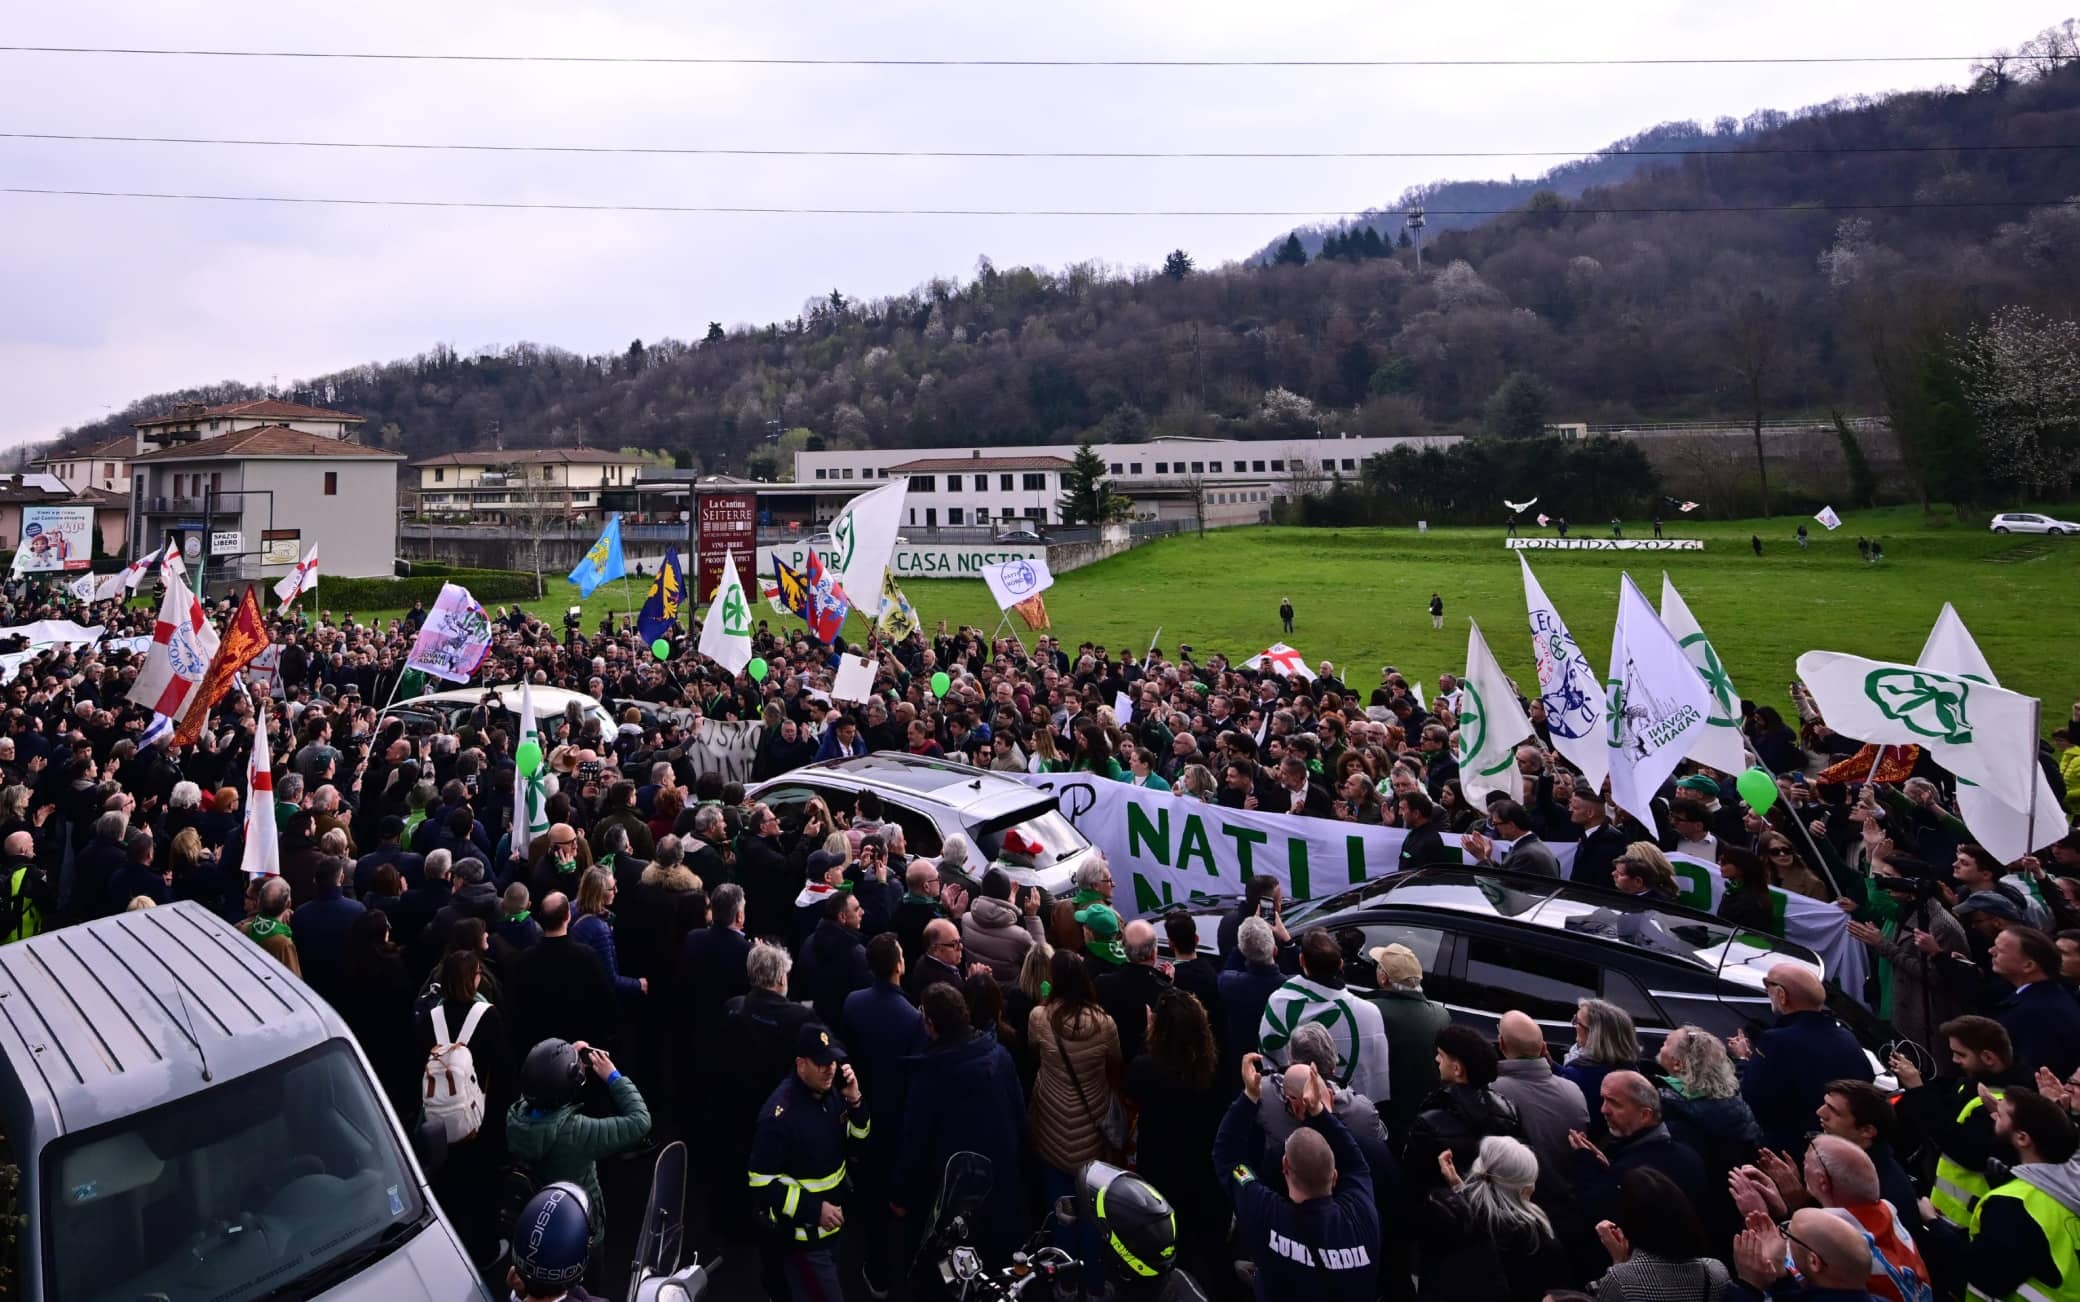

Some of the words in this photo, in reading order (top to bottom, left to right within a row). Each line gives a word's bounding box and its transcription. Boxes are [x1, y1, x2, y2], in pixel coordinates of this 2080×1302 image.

[709, 499, 719, 508] La
[720, 499, 746, 509] Cantina
[703, 508, 752, 521] SEITERRE
[1511, 539, 1619, 550] PONTIDA
[898, 552, 952, 572] CASA
[526, 1189, 568, 1264] DESIGN
